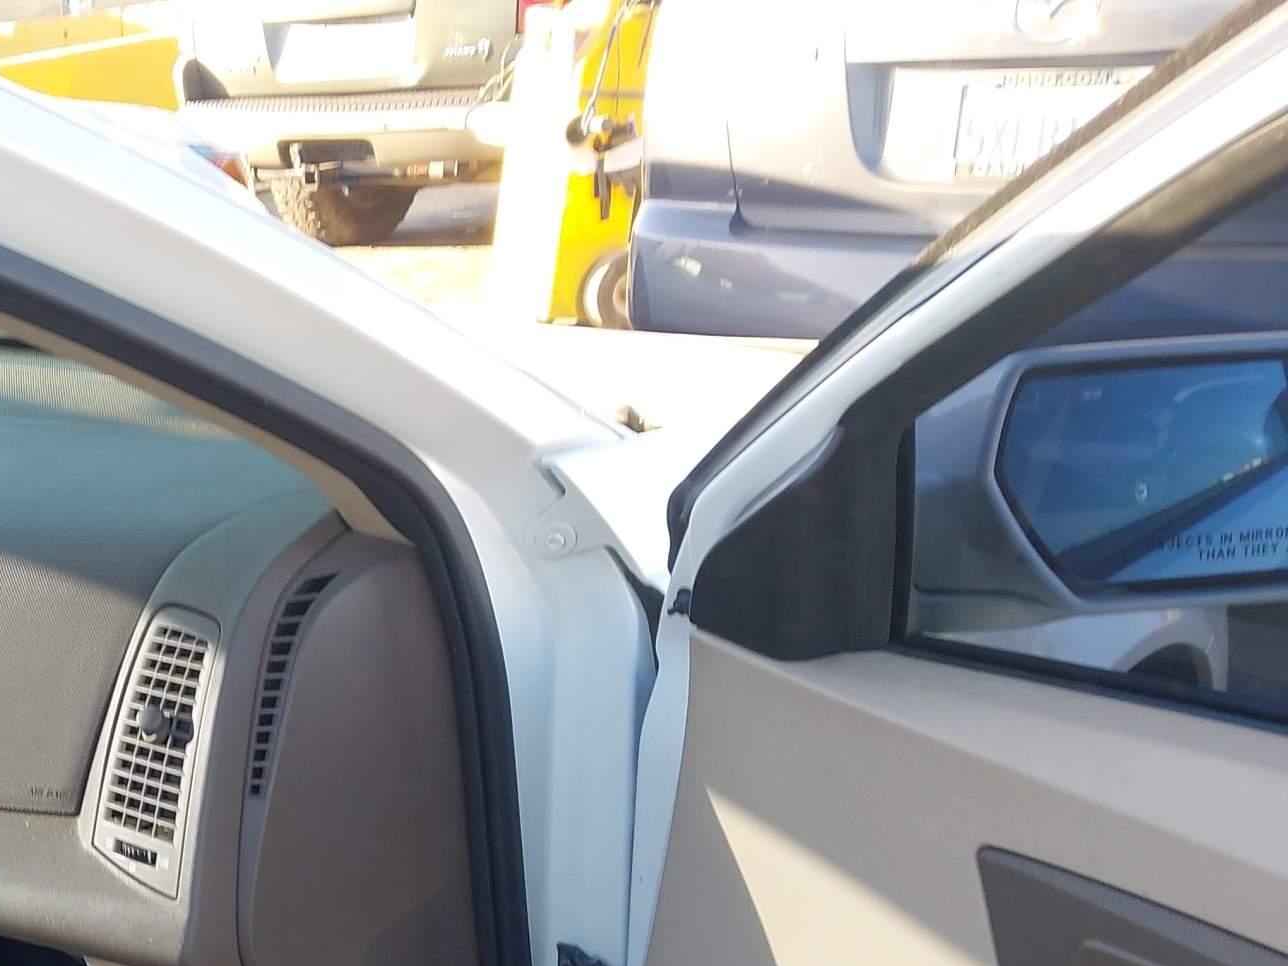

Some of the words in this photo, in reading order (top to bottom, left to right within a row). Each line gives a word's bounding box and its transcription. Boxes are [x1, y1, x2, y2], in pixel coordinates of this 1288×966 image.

[1219, 530, 1233, 544] IN
[1198, 546, 1237, 560] THAN
[1244, 543, 1279, 557] THEY
